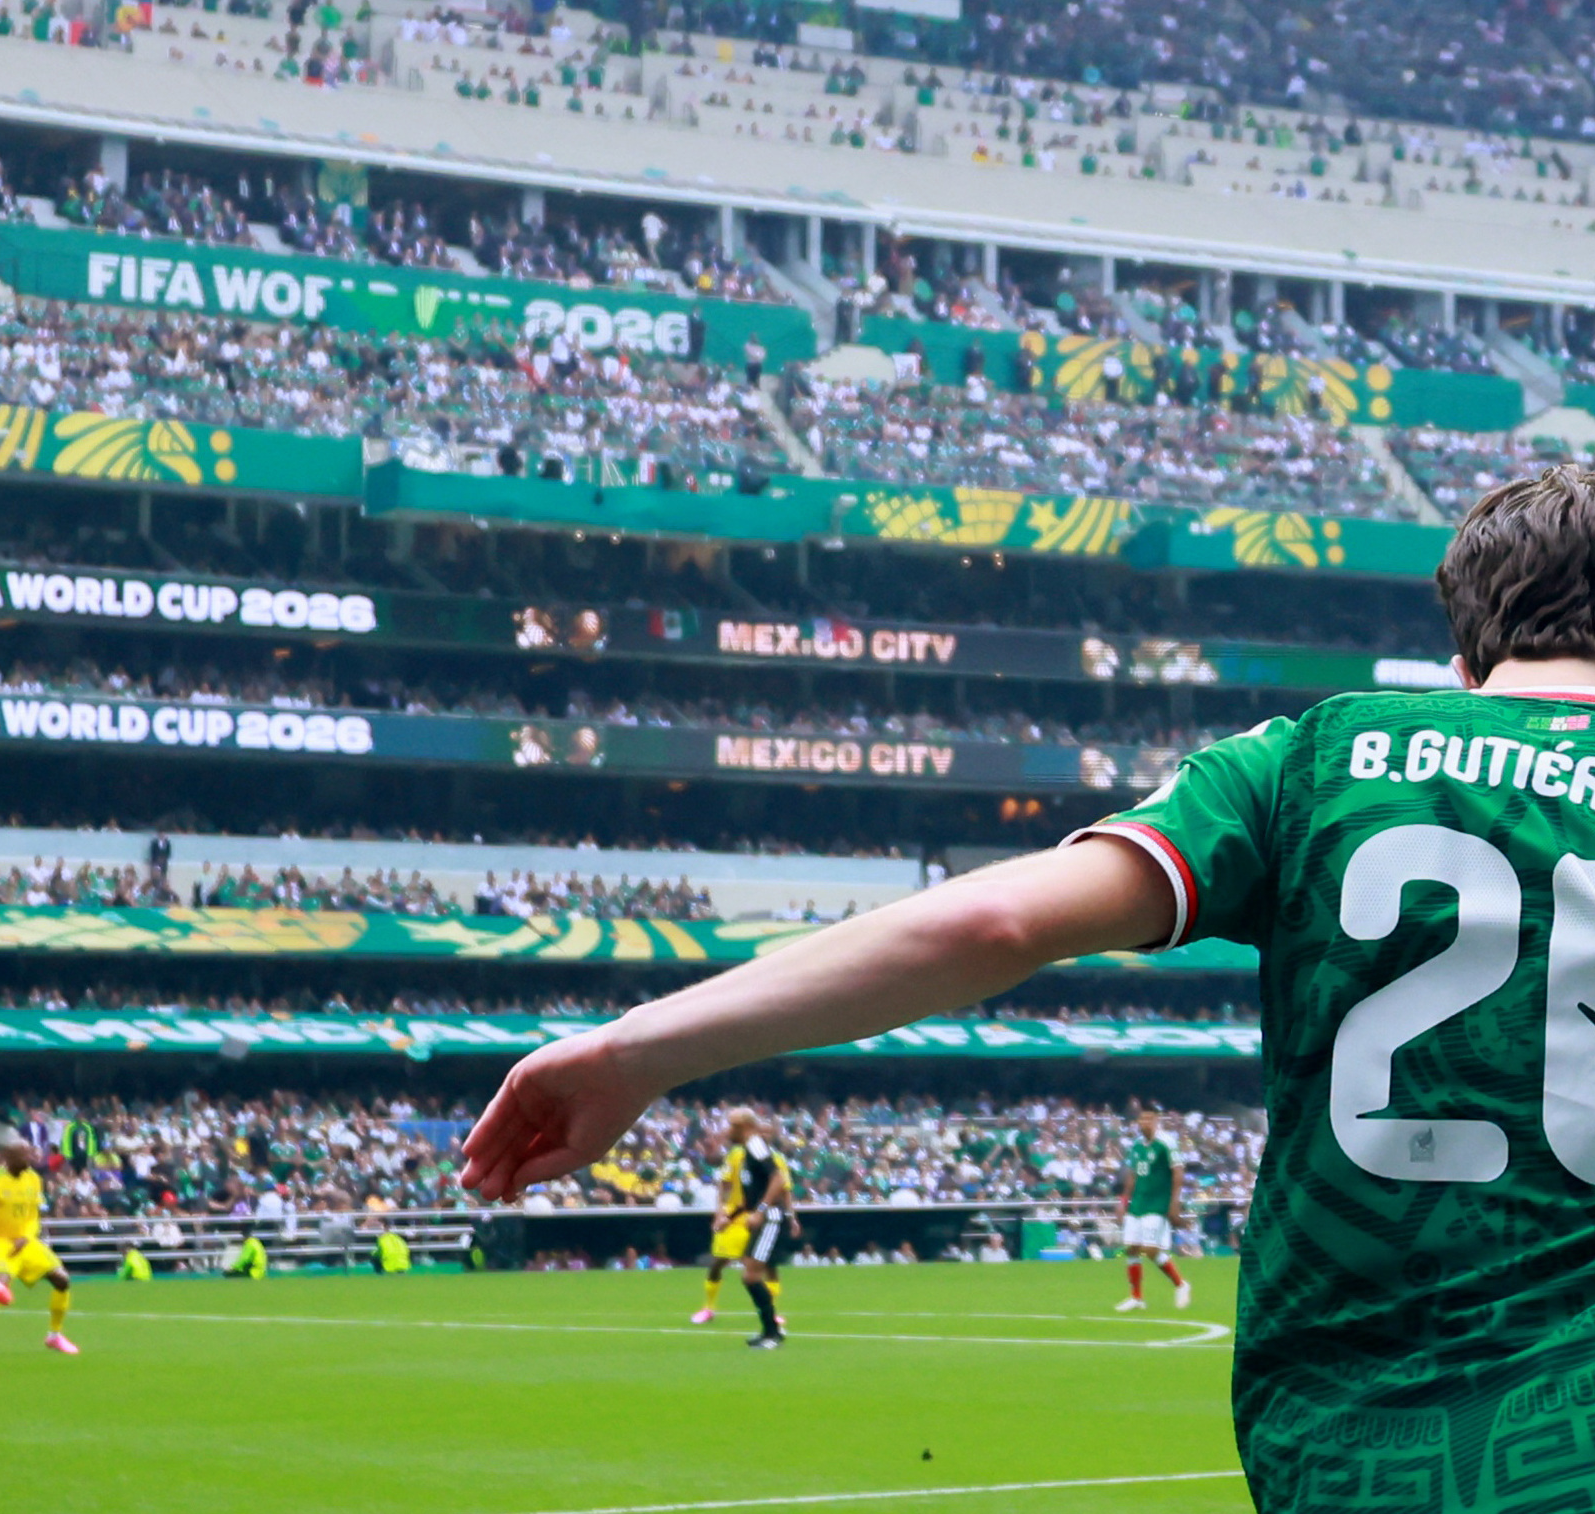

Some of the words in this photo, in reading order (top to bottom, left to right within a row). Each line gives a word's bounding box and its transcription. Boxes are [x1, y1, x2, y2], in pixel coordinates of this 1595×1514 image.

[88, 252, 204, 310] FIFA
[6, 571, 154, 620] WORLD
[156, 582, 238, 623] CUP
[239, 587, 377, 633] 2026
[871, 630, 956, 663] CITY
[1, 698, 150, 744] WORLD
[152, 707, 234, 748] CUP
[235, 710, 373, 755] 2026
[716, 735, 862, 773] MEXICO
[869, 742, 954, 776] CITY
